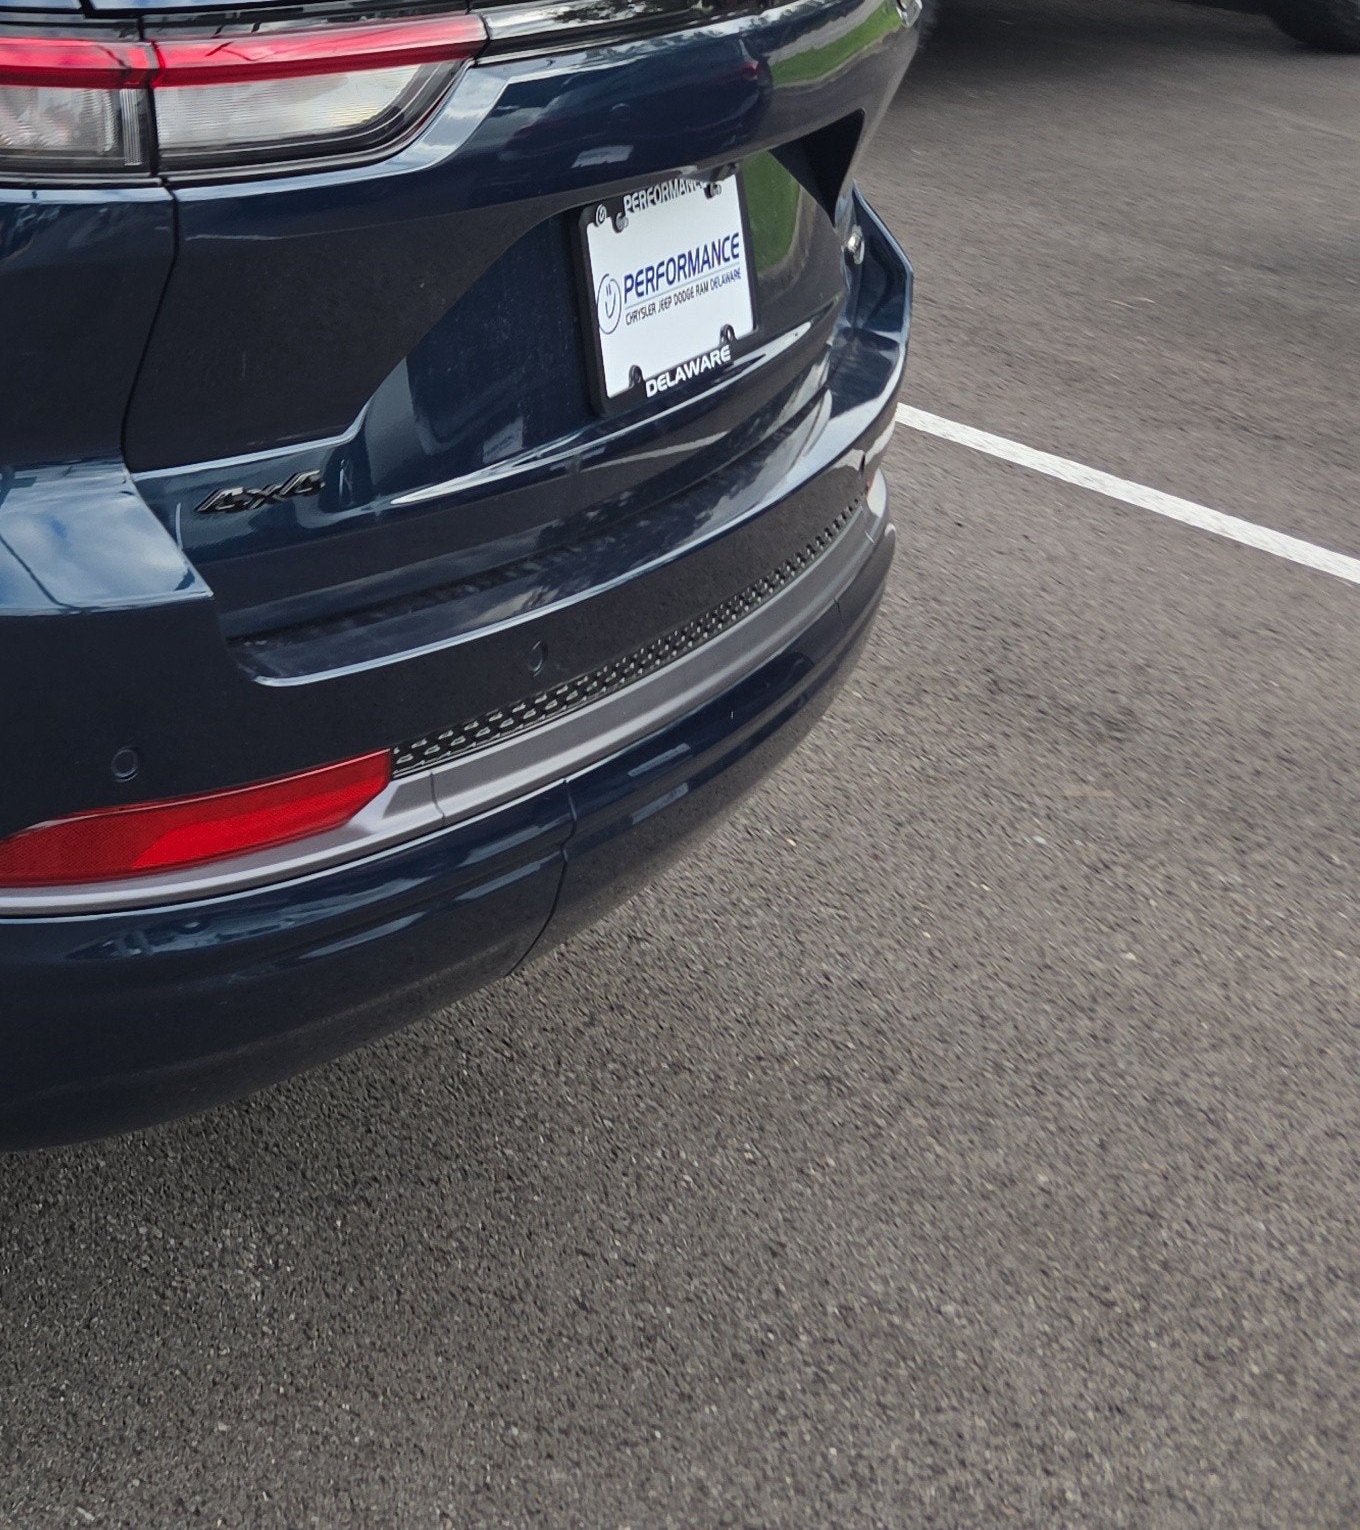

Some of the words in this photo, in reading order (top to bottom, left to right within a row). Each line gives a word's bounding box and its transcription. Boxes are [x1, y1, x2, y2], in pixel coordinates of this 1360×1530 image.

[623, 232, 740, 304] PERFORMANCE
[625, 302, 656, 326] CHRYSLER
[658, 296, 673, 313] JEEP
[673, 286, 695, 306] DODGE
[695, 281, 709, 296] RAM
[710, 267, 741, 290] DELAWARE
[646, 345, 732, 398] DELAWARE
